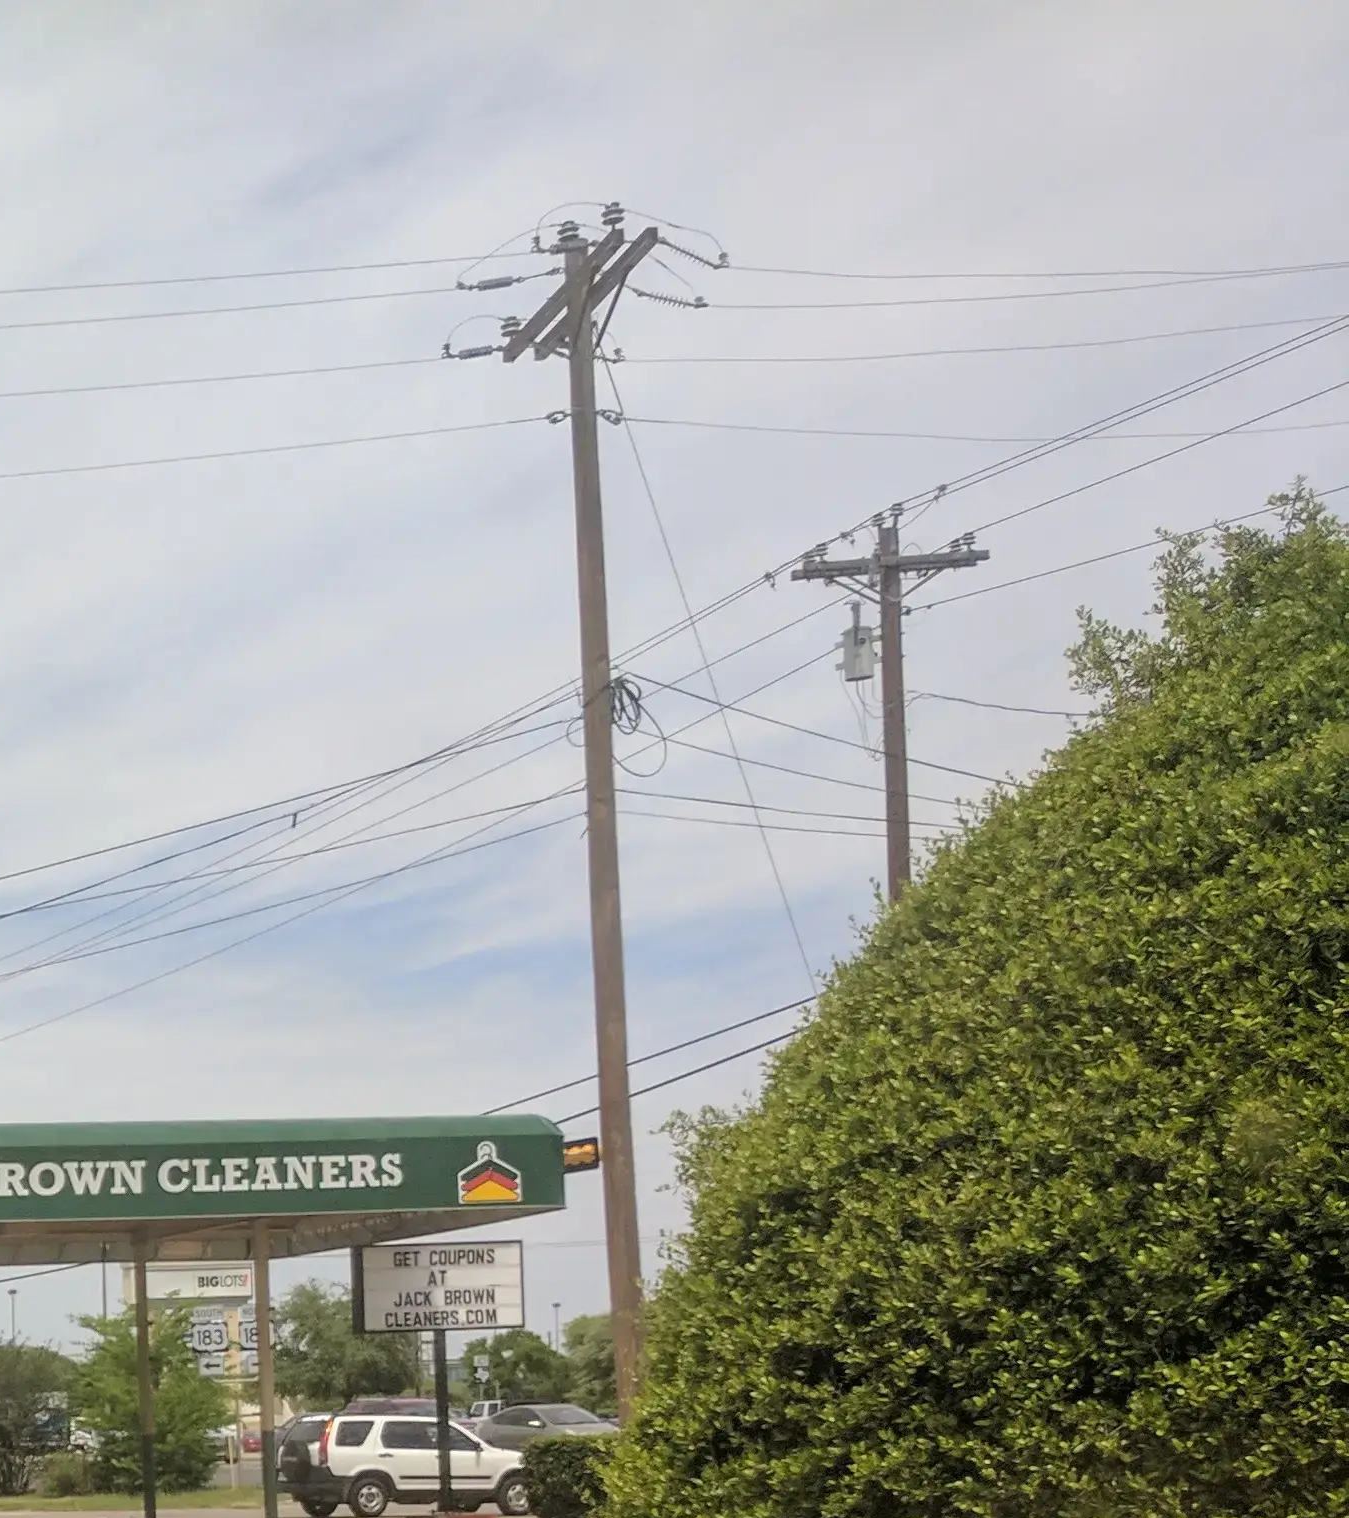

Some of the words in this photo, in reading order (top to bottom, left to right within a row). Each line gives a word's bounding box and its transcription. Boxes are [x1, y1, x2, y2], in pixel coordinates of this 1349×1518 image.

[157, 1153, 403, 1194] CLEANERS
[393, 1251, 420, 1267] GET
[429, 1248, 495, 1266] COUPONS
[427, 1270, 447, 1286] AT
[394, 1291, 432, 1307] JACK
[444, 1288, 496, 1305] BROWN
[194, 1309, 223, 1319] SOUTH
[385, 1308, 498, 1328] CLEANERS.COM
[196, 1328, 224, 1346] 183
[243, 1327, 258, 1343] 18
